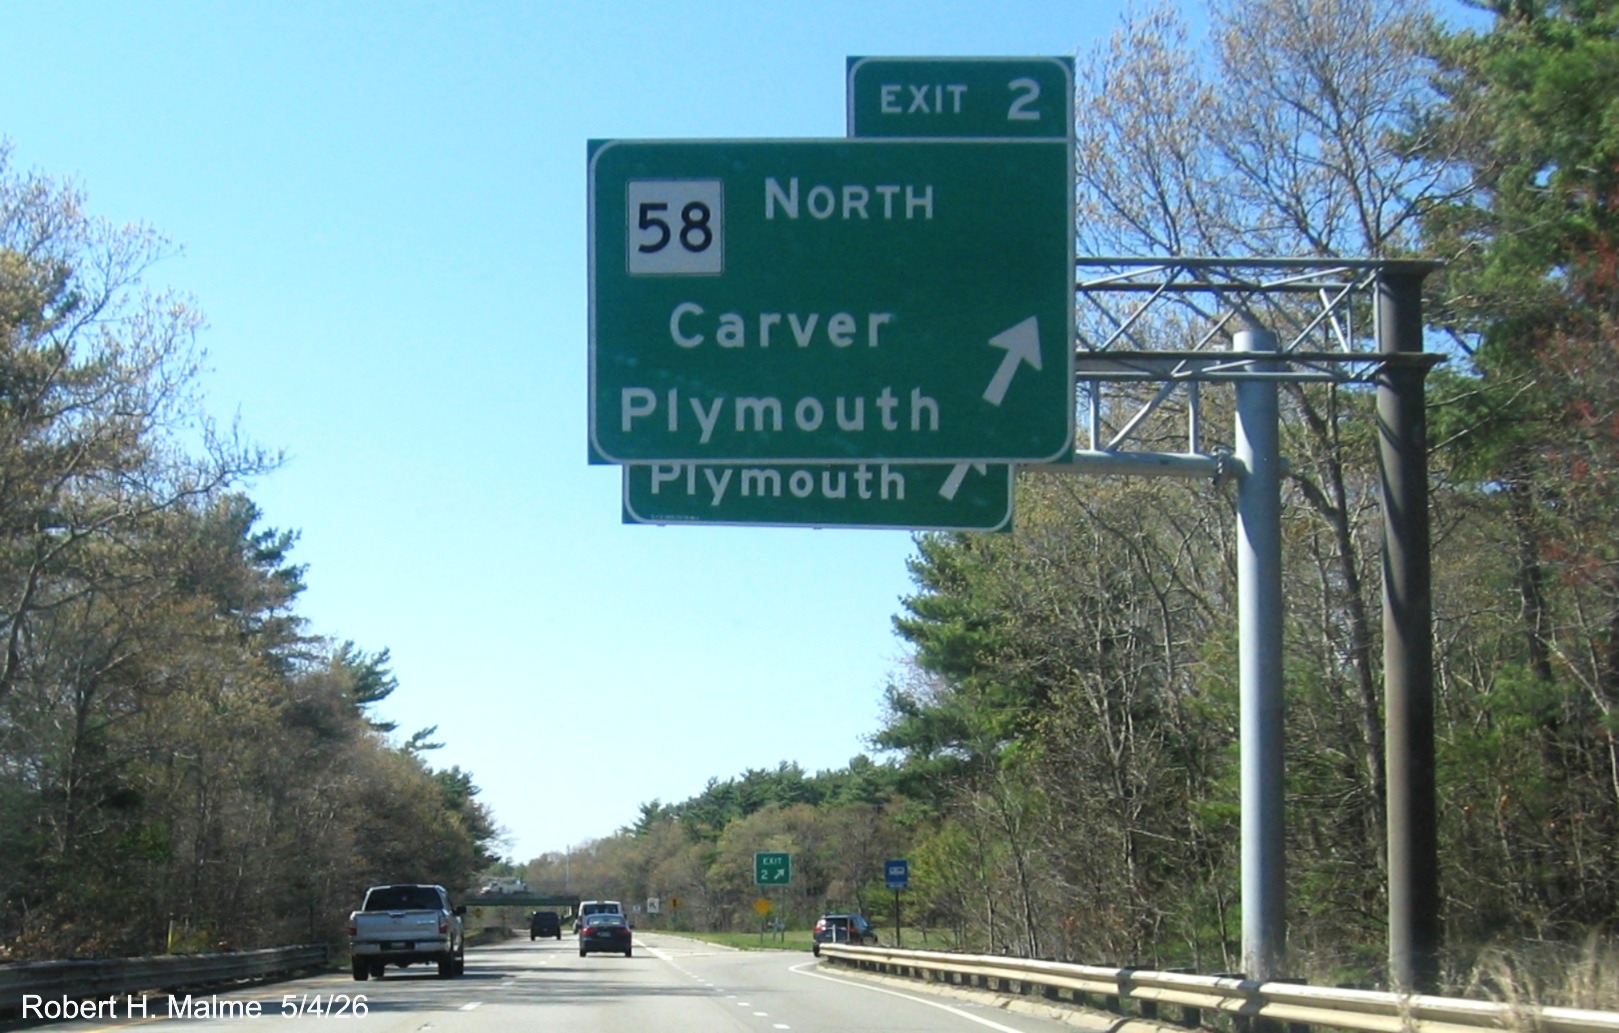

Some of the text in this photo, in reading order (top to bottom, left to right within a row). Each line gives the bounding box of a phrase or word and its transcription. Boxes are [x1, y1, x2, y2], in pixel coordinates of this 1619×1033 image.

[880, 77, 1041, 121] EXIT 2
[764, 176, 934, 220] NORTH
[637, 201, 713, 254] 58
[669, 301, 893, 348] Carver
[621, 386, 940, 444] Plymouth
[651, 464, 905, 506] Plymouth
[761, 869, 769, 880] 2
[762, 857, 782, 865] EXIT
